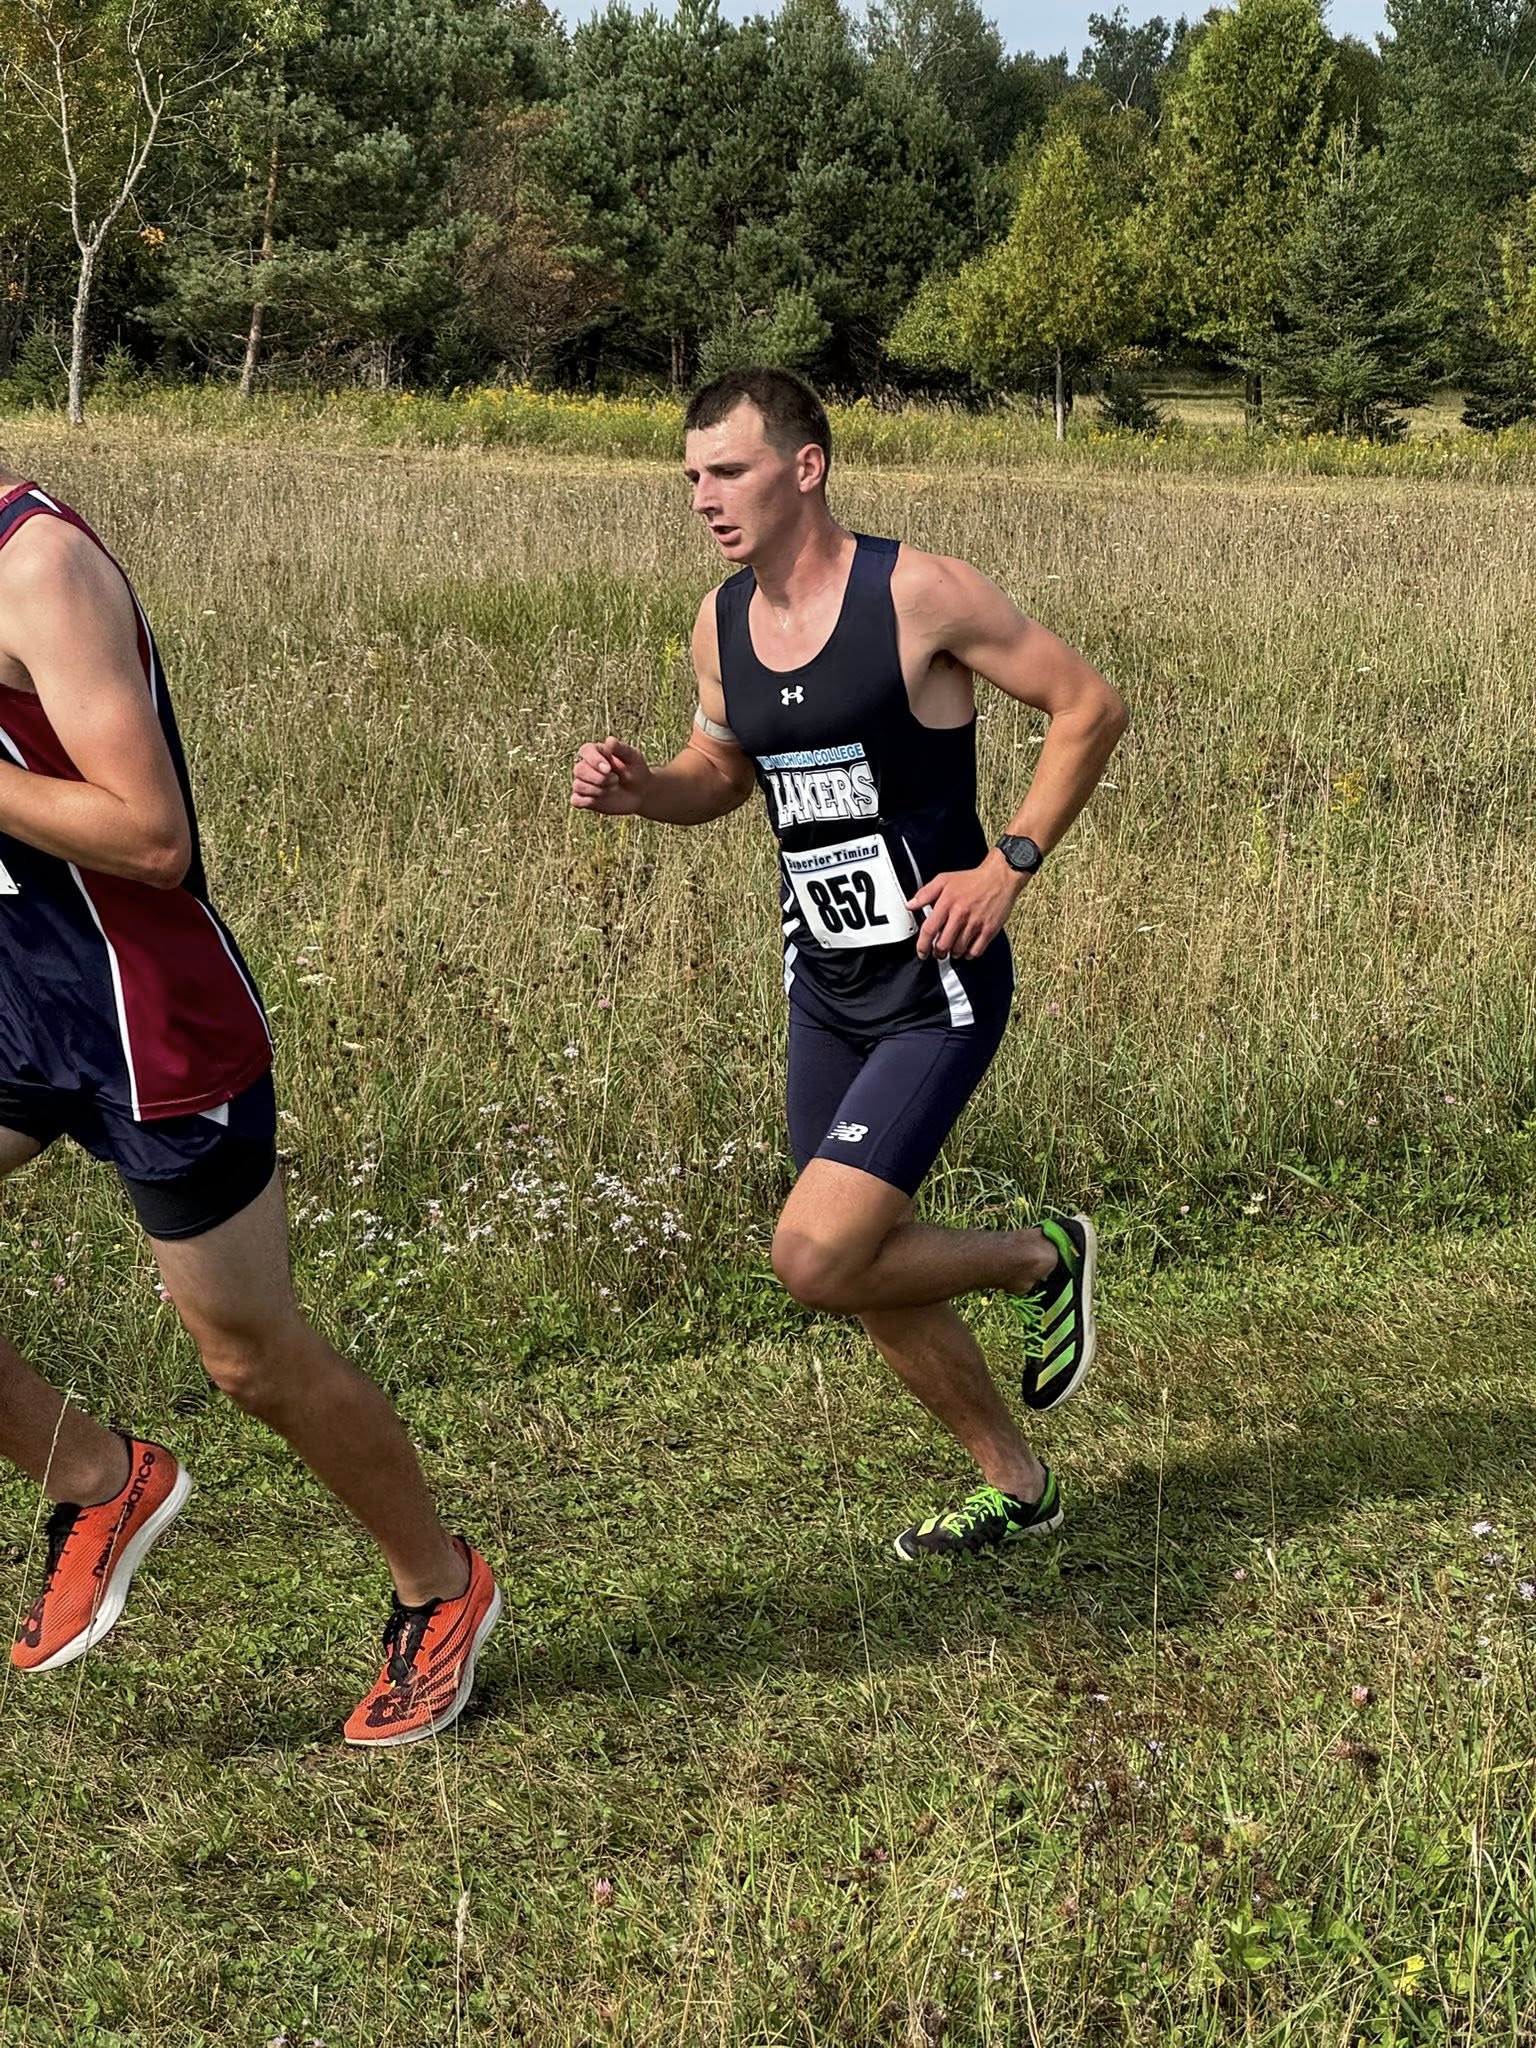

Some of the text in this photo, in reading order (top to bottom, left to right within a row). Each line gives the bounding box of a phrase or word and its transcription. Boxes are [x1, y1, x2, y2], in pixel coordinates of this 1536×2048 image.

[770, 751, 815, 768] MICHIGAN
[814, 743, 865, 765] COLLEGE
[765, 761, 879, 828] LAKERS
[787, 844, 878, 870] Superior Timing
[806, 870, 890, 933] 852
